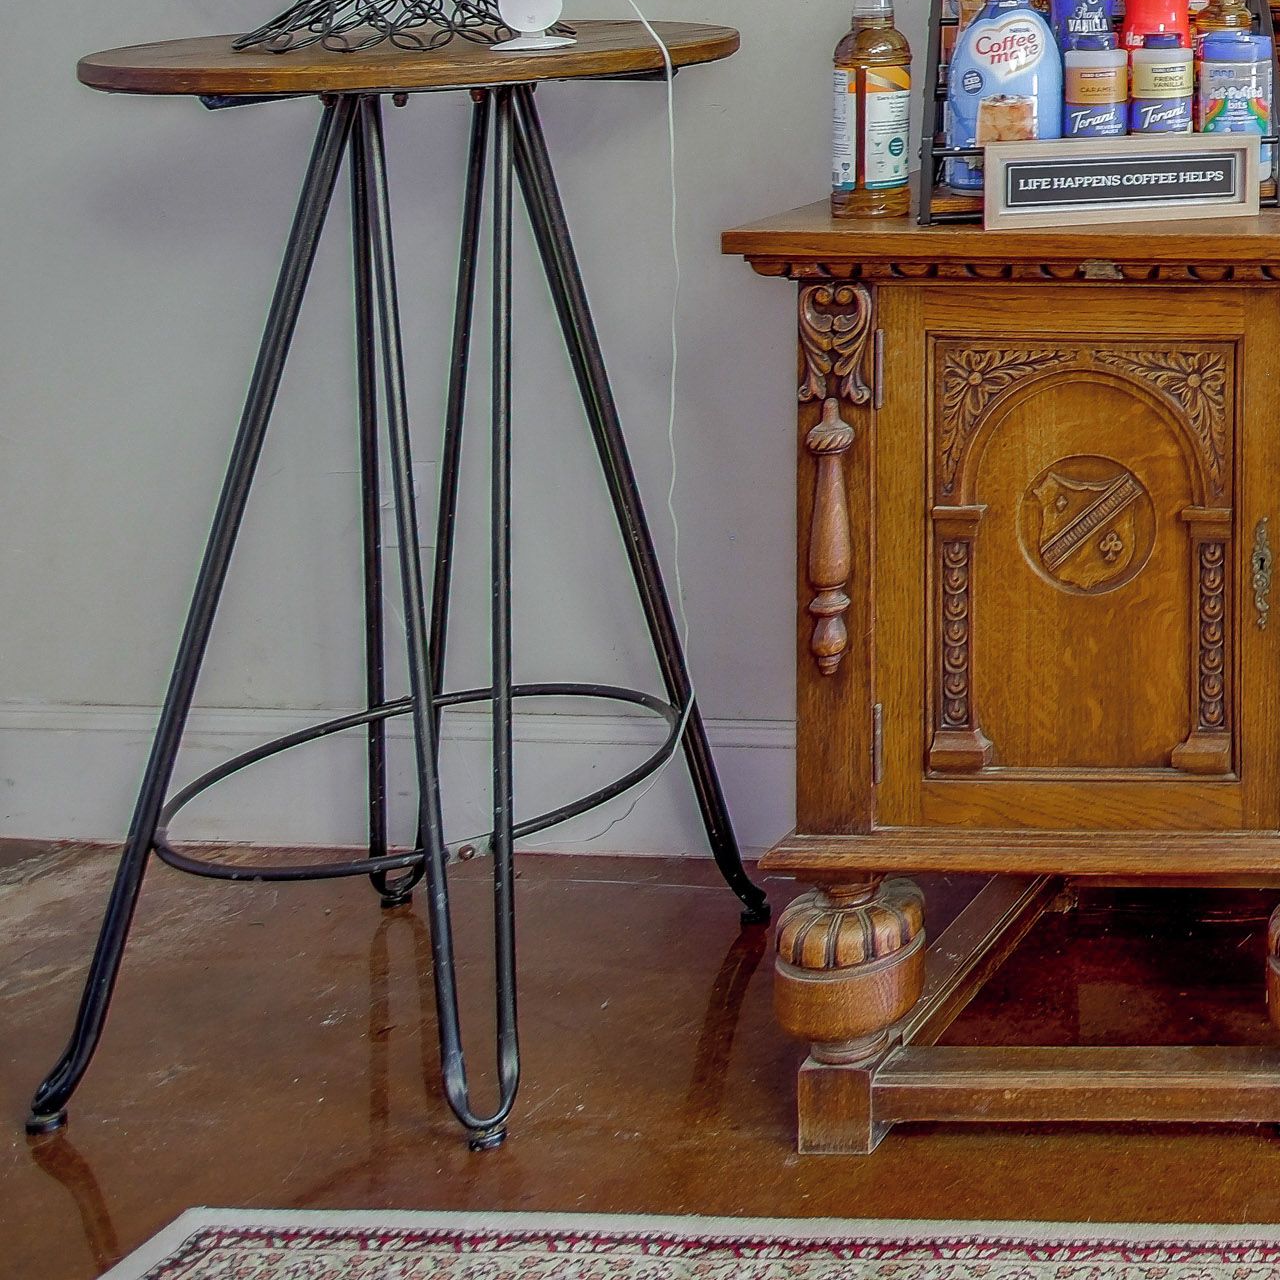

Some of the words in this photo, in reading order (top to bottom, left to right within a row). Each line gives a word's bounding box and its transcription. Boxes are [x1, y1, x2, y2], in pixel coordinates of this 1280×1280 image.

[1067, 19, 1109, 33] VANILLA
[976, 33, 1036, 55] Coffee
[1070, 108, 1117, 133] Torani
[1140, 102, 1187, 129] Torani
[1019, 177, 1051, 191] LIFE
[1052, 175, 1121, 190] HAPPENS
[1122, 172, 1177, 186] COFFEE
[1178, 170, 1224, 183] HELPS
